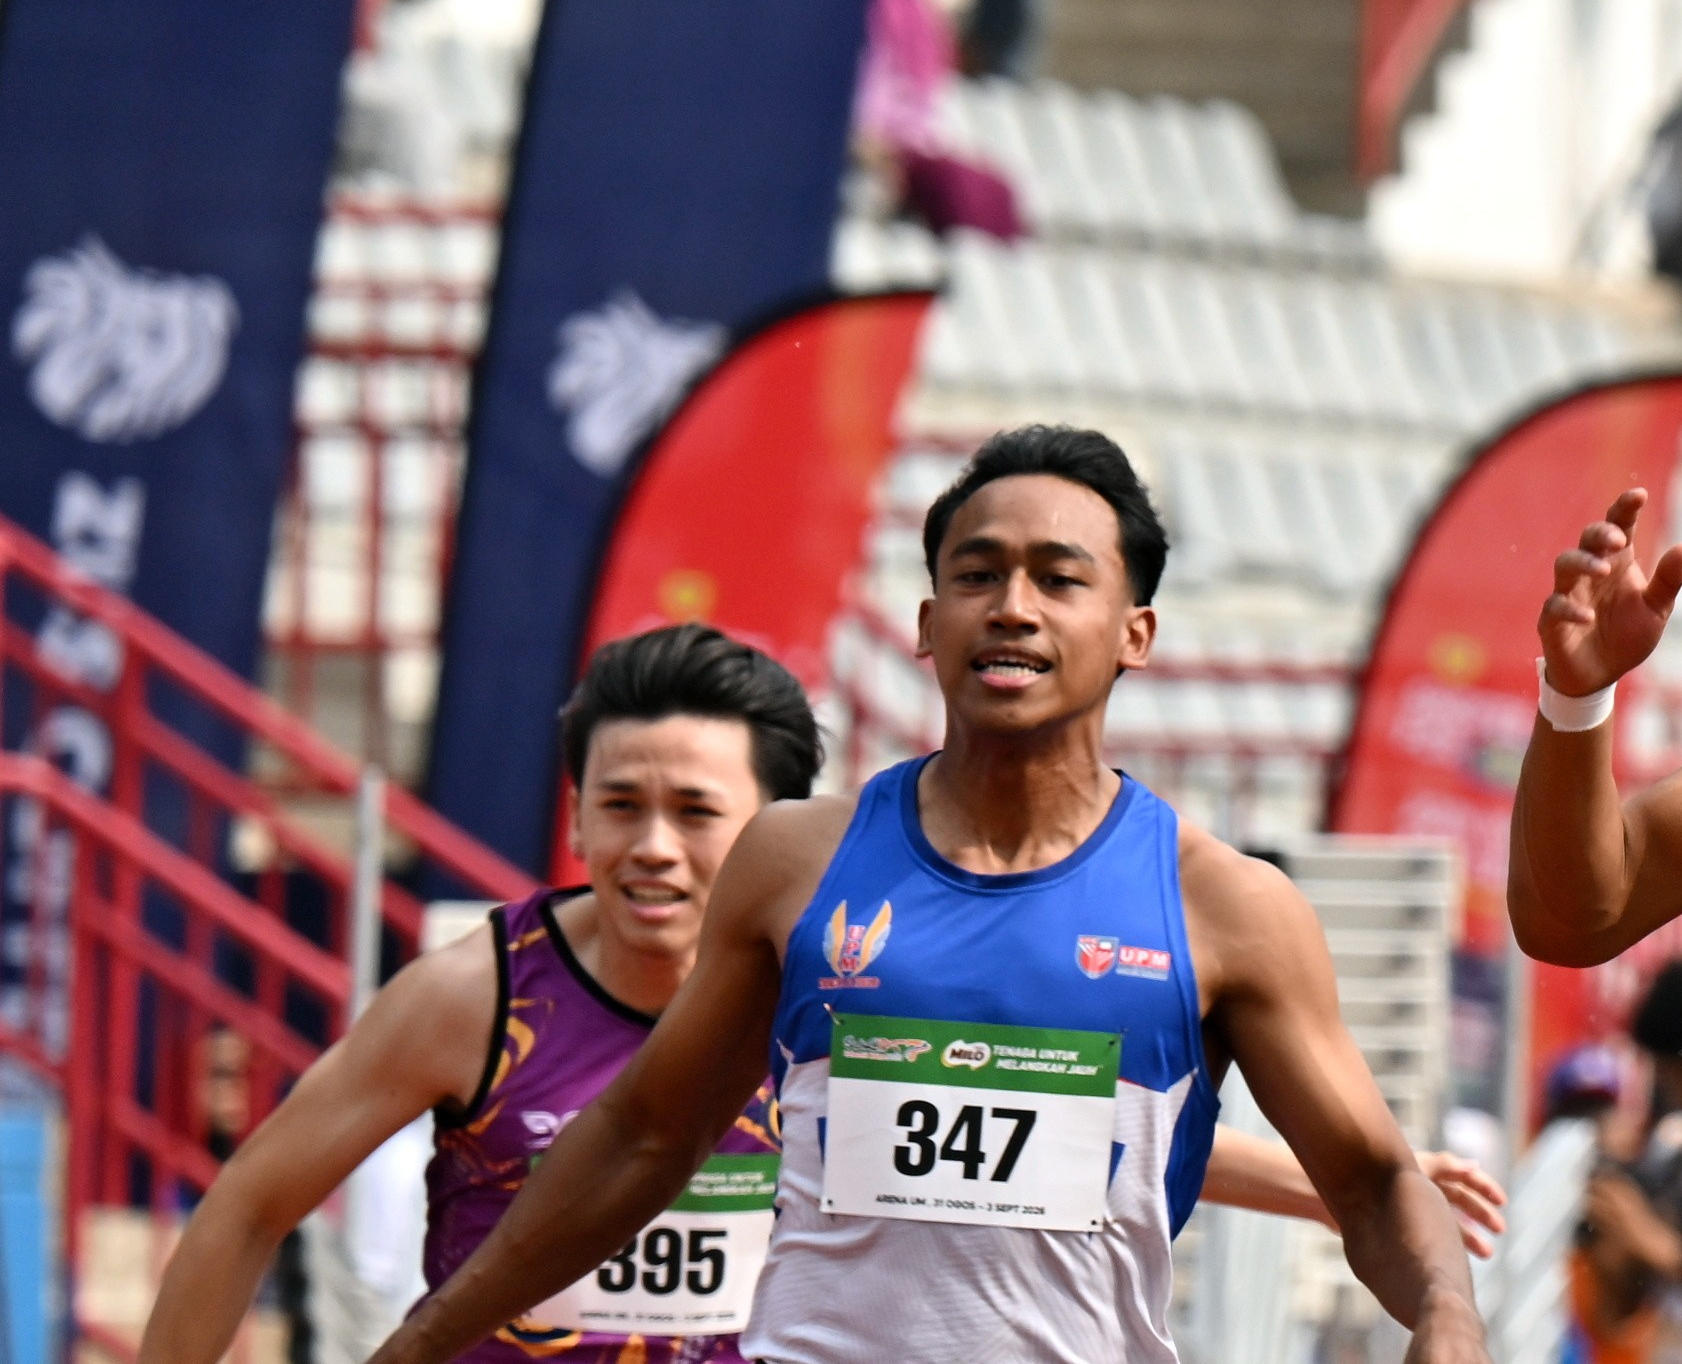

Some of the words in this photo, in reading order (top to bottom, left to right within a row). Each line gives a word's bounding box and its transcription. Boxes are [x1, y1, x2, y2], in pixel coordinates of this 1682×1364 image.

[1120, 947, 1168, 967] UPM
[949, 1047, 985, 1061] MILO
[894, 1099, 1037, 1183] 347
[876, 1193, 907, 1205] ARENA
[995, 1203, 1019, 1213] SEPT
[597, 1227, 728, 1295] 395
